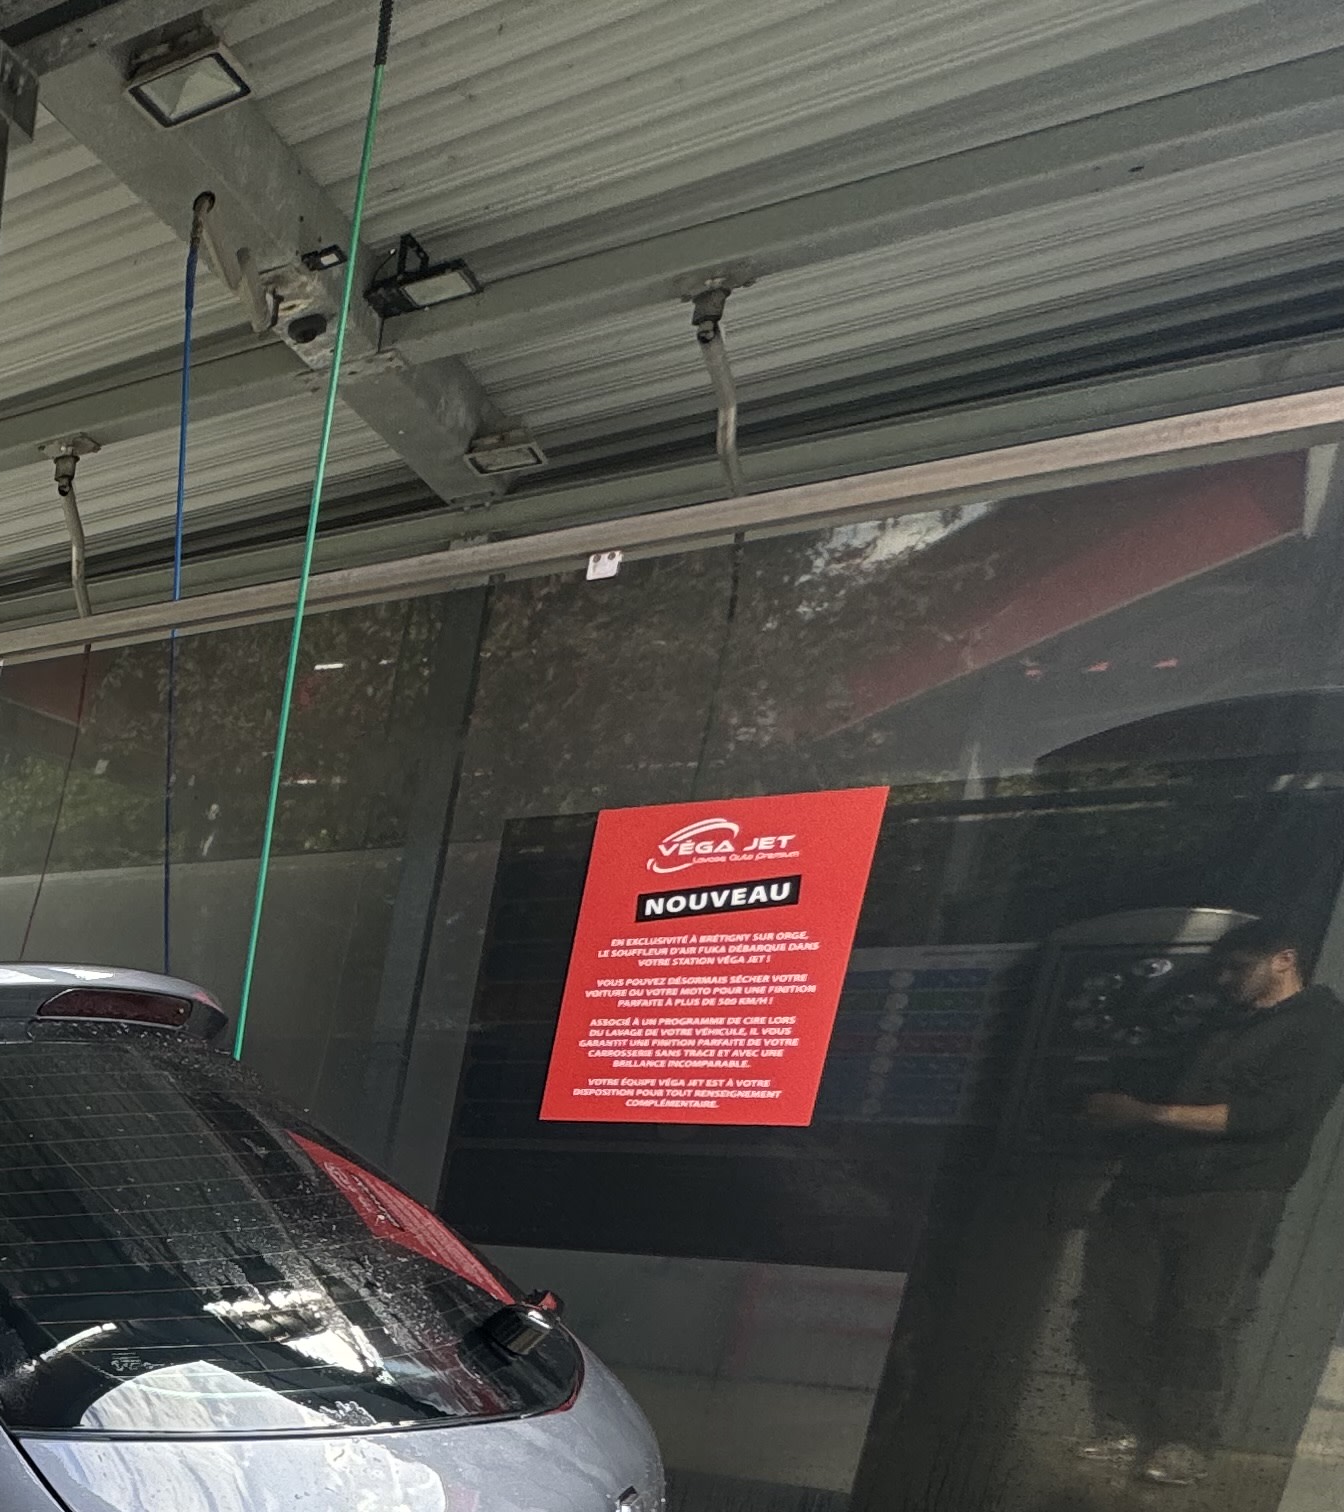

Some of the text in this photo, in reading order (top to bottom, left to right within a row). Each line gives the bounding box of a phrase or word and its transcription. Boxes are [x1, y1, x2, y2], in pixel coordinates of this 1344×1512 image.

[658, 834, 796, 856] VÉGA JET
[644, 882, 791, 916] NOUVEAU
[626, 935, 688, 946] EXCLUSIVITÉ
[689, 934, 697, 943] À
[699, 933, 752, 943] BRÉTIGNY
[752, 932, 775, 941] SUR
[598, 942, 820, 958] LE SOUFFLEUR D'AIR FUKA DÉBARQUE DANS
[638, 958, 670, 966] VOTRE
[672, 957, 715, 966] STATION
[717, 955, 745, 964] VÉGA
[747, 955, 766, 963] JET
[597, 974, 808, 987] VOUS POUVEZ DÉSORMAIS SÉCHER VOTRE
[585, 985, 817, 998] VOITURE OU VOTRE MOTO POUR UNE FINITION
[617, 999, 664, 1007] PARFAITE
[665, 998, 673, 1006] À
[674, 998, 700, 1006] PLUS
[701, 998, 716, 1006] DE
[590, 1016, 796, 1026] ASSOCIÉ À UN PROGRAMME DE CIRE LORS
[589, 1029, 604, 1037] DU
[605, 1029, 643, 1037] LAVAGE
[660, 1028, 693, 1036] VOTRE
[761, 1027, 792, 1035] VOUS
[579, 1039, 628, 1047] GARANTIT
[629, 1039, 650, 1047] UNE
[697, 1038, 746, 1047] PARFAITE
[747, 1038, 762, 1046] DE
[764, 1038, 800, 1046] VOTRE
[655, 1049, 682, 1057] SANS
[683, 1049, 716, 1057] TRACE
[717, 1049, 731, 1057] ET
[731, 1049, 761, 1057] AVEC
[761, 1049, 784, 1057] UNE
[621, 1077, 657, 1086] ÉQUIPE
[659, 1077, 685, 1086] VÉGA
[687, 1079, 705, 1087] JET
[706, 1079, 726, 1087] EST
[725, 1078, 733, 1087] À
[736, 1079, 771, 1087] VOTRE
[665, 1089, 693, 1097] TOUT
[694, 1089, 783, 1098] RENSEIGNEMENT
